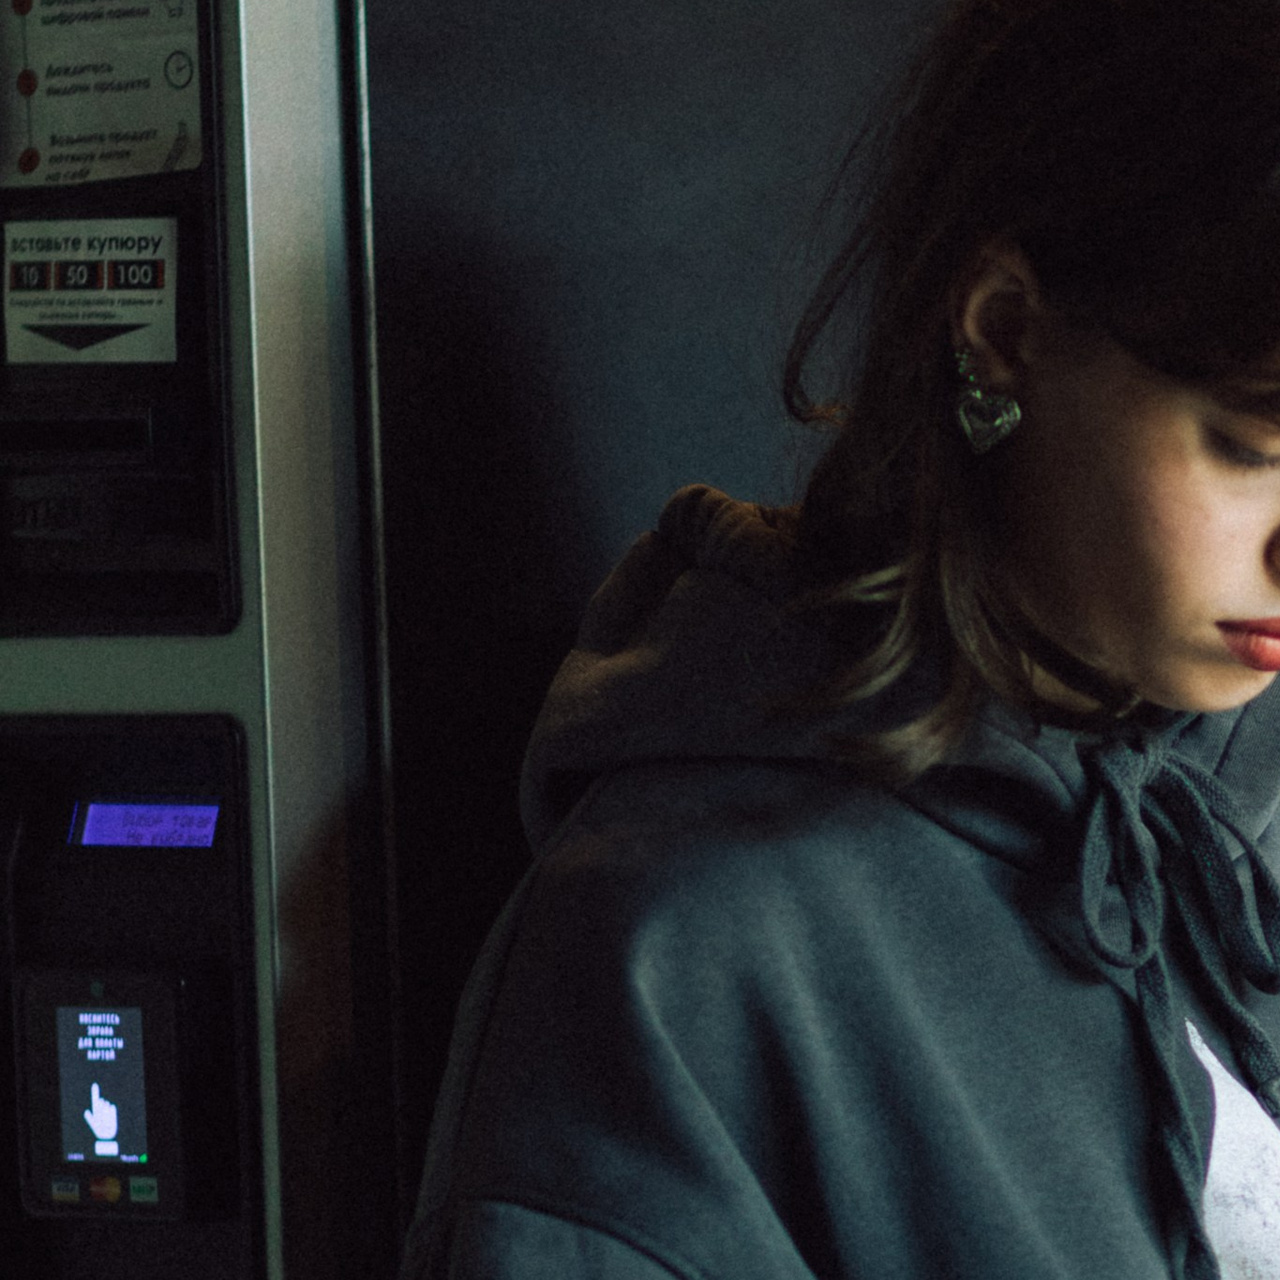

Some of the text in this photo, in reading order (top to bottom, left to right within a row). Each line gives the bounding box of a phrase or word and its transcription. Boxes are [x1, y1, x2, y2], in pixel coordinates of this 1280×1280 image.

[11, 235, 163, 255] вставьте купюру
[22, 265, 152, 285] 10 50 100
